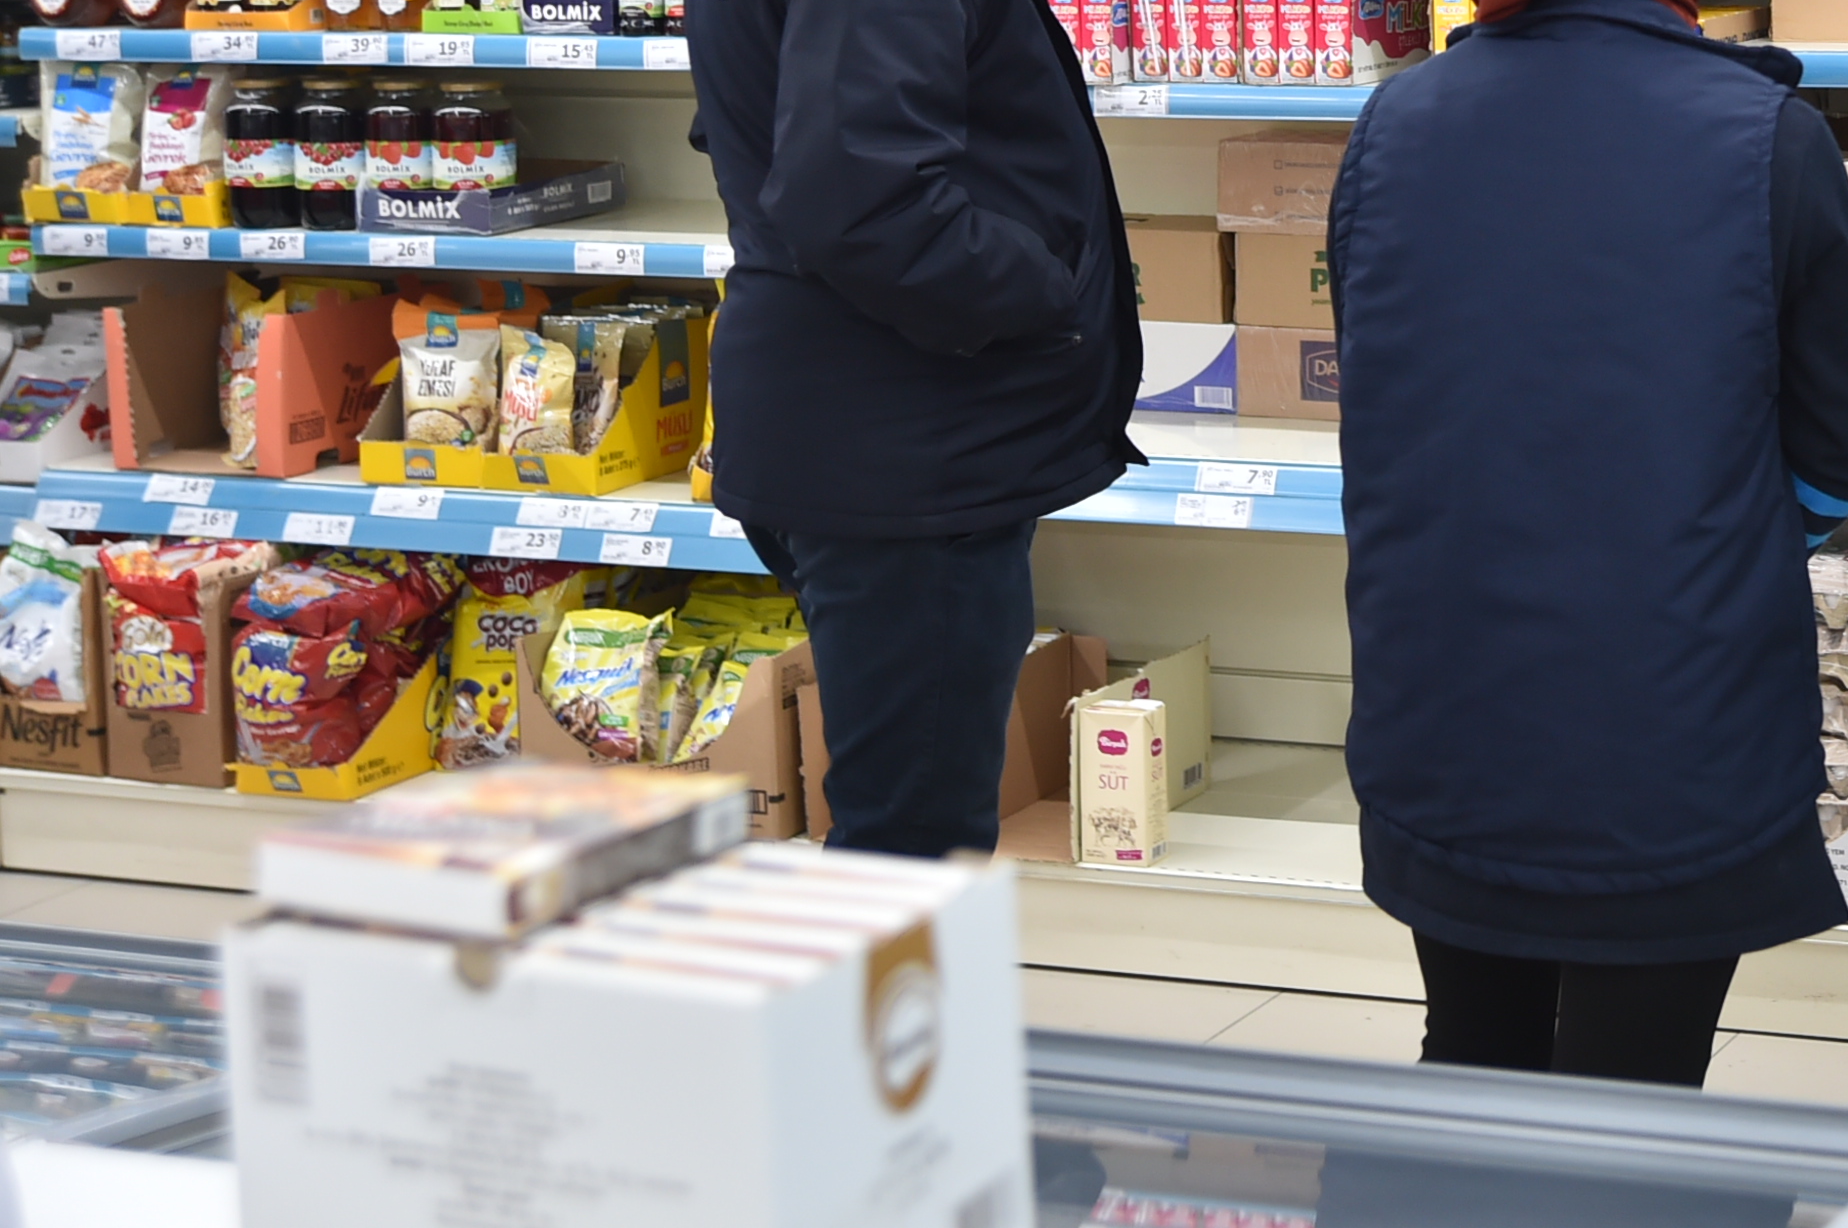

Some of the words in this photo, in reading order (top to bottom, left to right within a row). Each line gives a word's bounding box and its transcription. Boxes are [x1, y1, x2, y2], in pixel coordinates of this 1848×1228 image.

[531, 1, 601, 21] BOLMİX
[378, 195, 461, 219] BOLMİX
[486, 633, 516, 652] pop
[1099, 775, 1128, 790] SÜT
